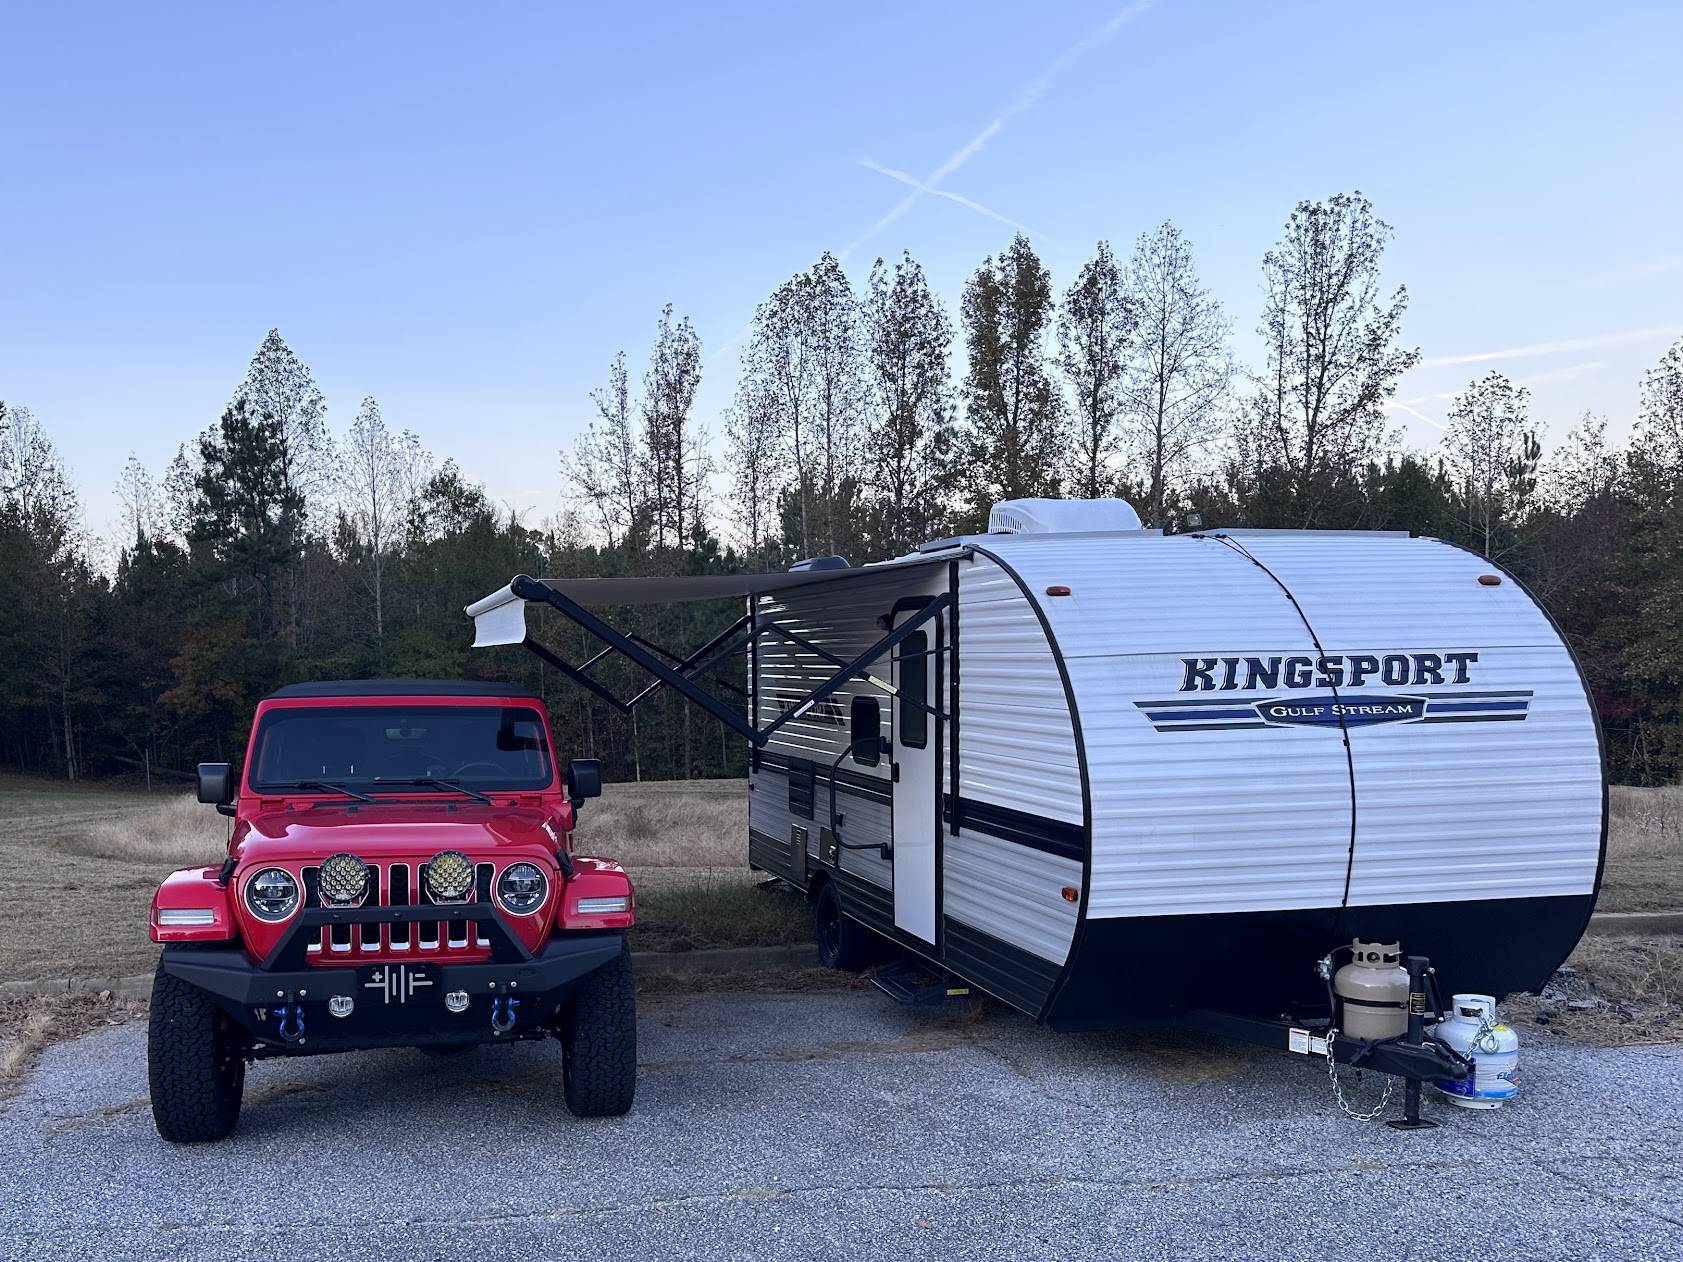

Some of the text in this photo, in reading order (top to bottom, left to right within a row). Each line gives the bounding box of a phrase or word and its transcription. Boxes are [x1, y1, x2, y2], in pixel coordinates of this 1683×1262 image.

[1178, 652, 1479, 692] KINGSPORT
[1269, 704, 1413, 717] GULF STREAM
